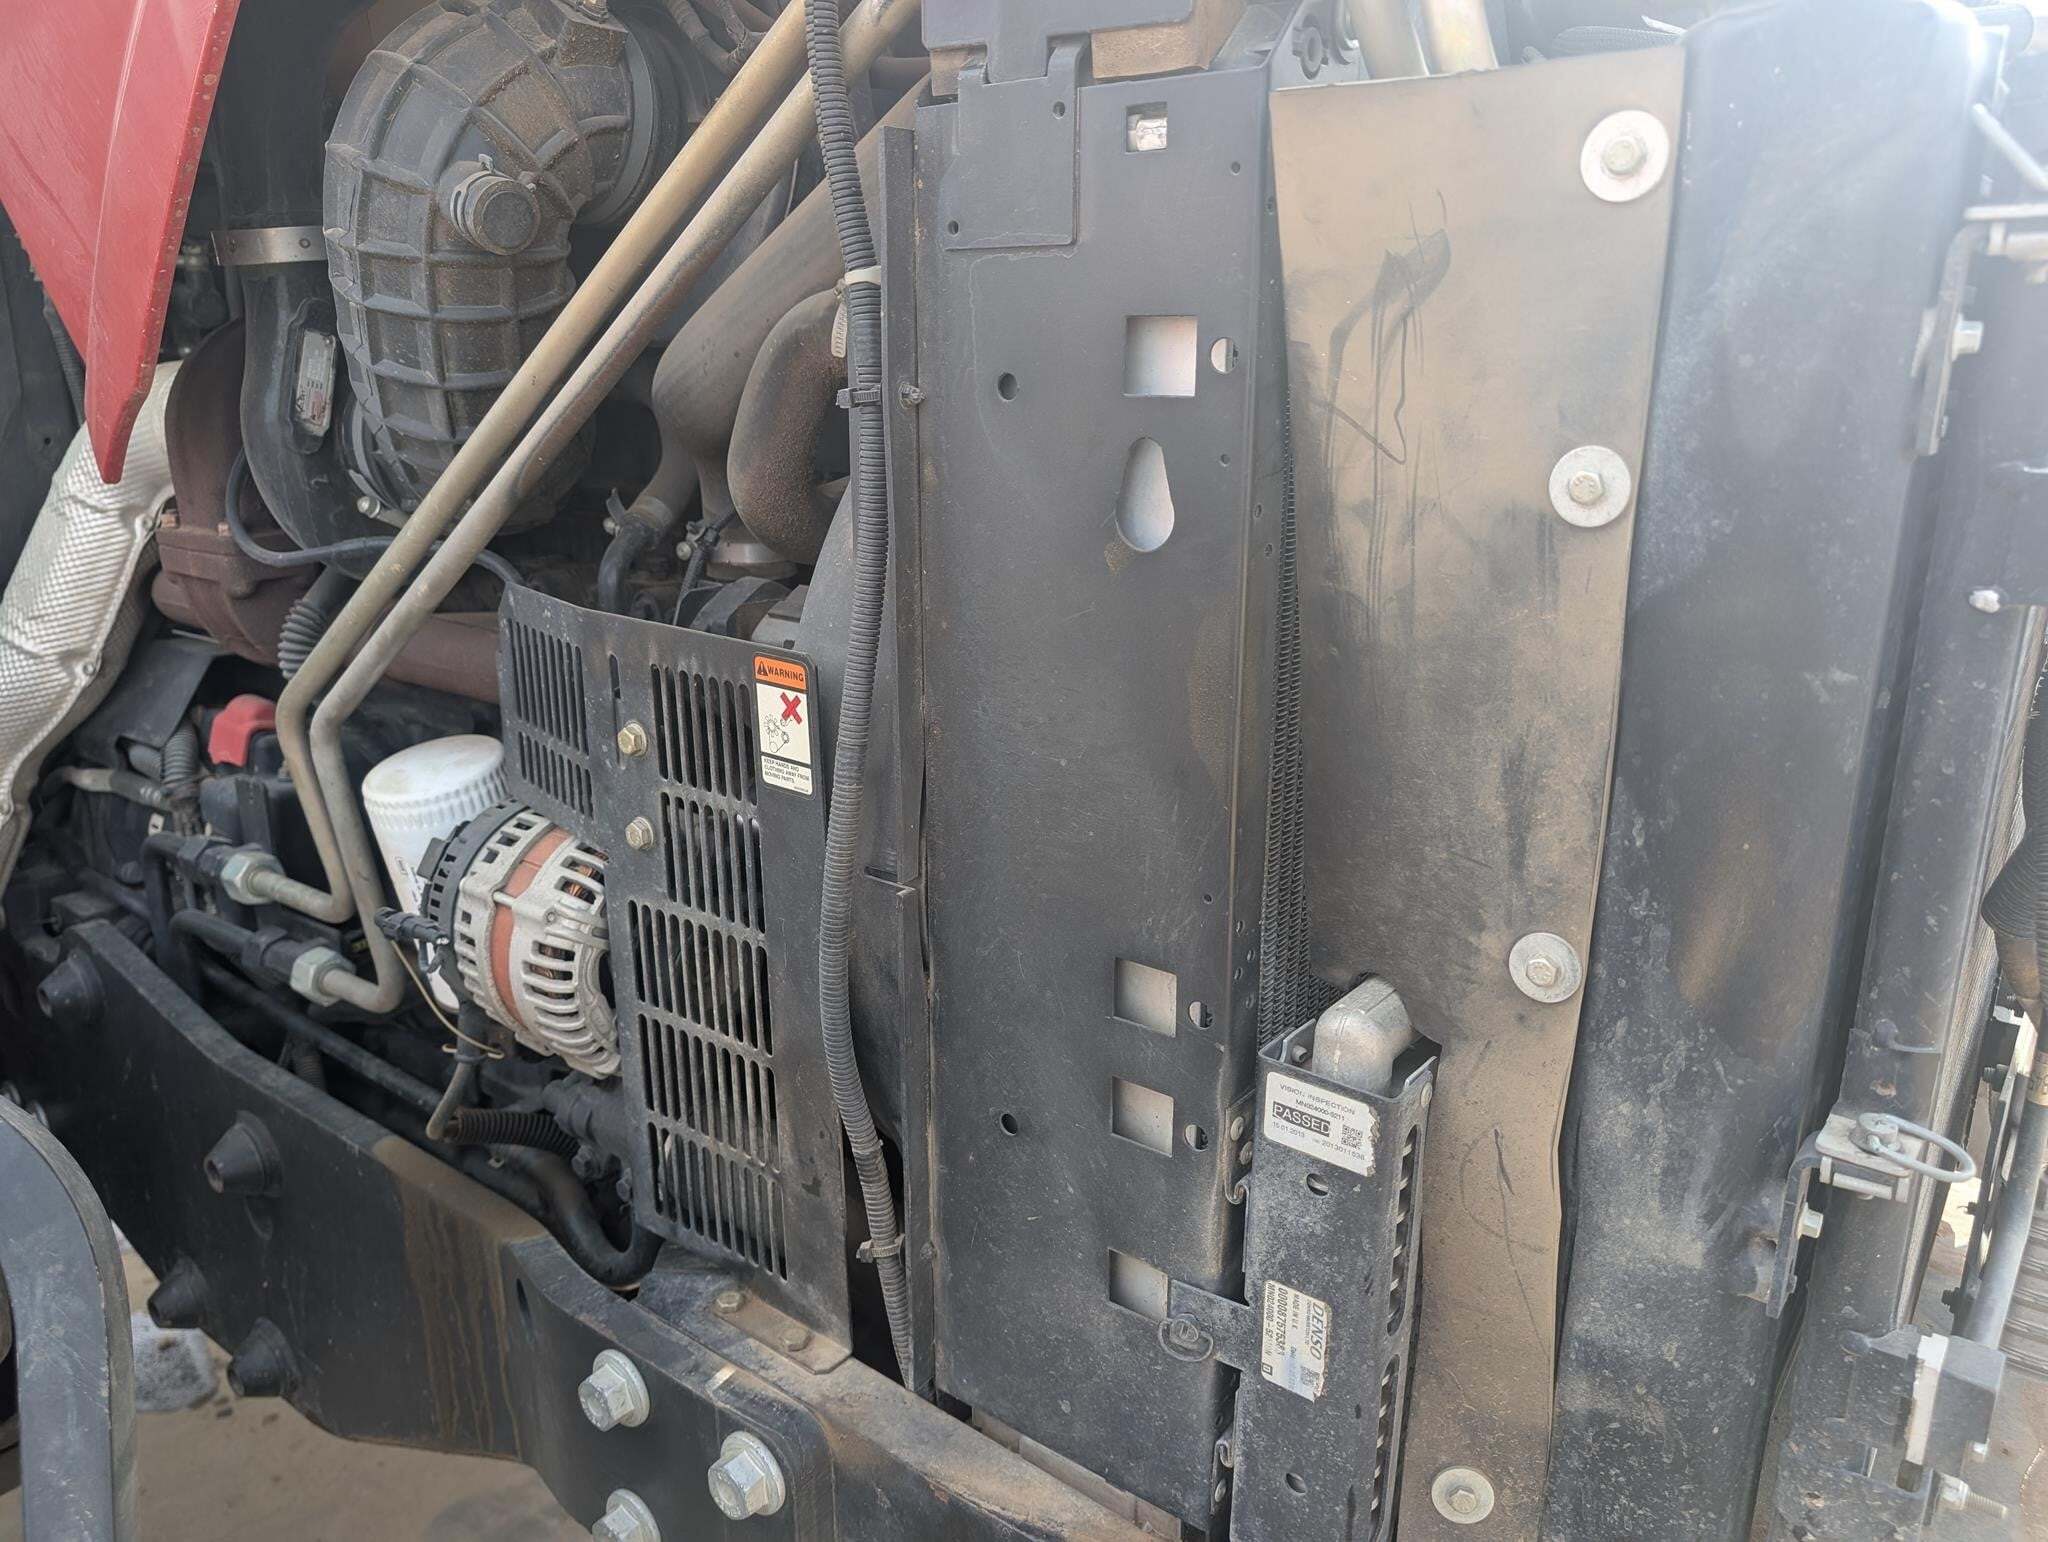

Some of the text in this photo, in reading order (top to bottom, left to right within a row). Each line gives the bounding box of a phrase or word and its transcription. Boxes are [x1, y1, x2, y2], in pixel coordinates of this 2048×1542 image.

[767, 665, 804, 681] WARNING
[764, 764, 785, 774] CLOTHING
[775, 761, 789, 769] HANDS
[764, 770, 795, 783] MOVING PARTS
[1273, 1103, 1330, 1136] PASSED
[1310, 1302, 1325, 1361] DENSO
